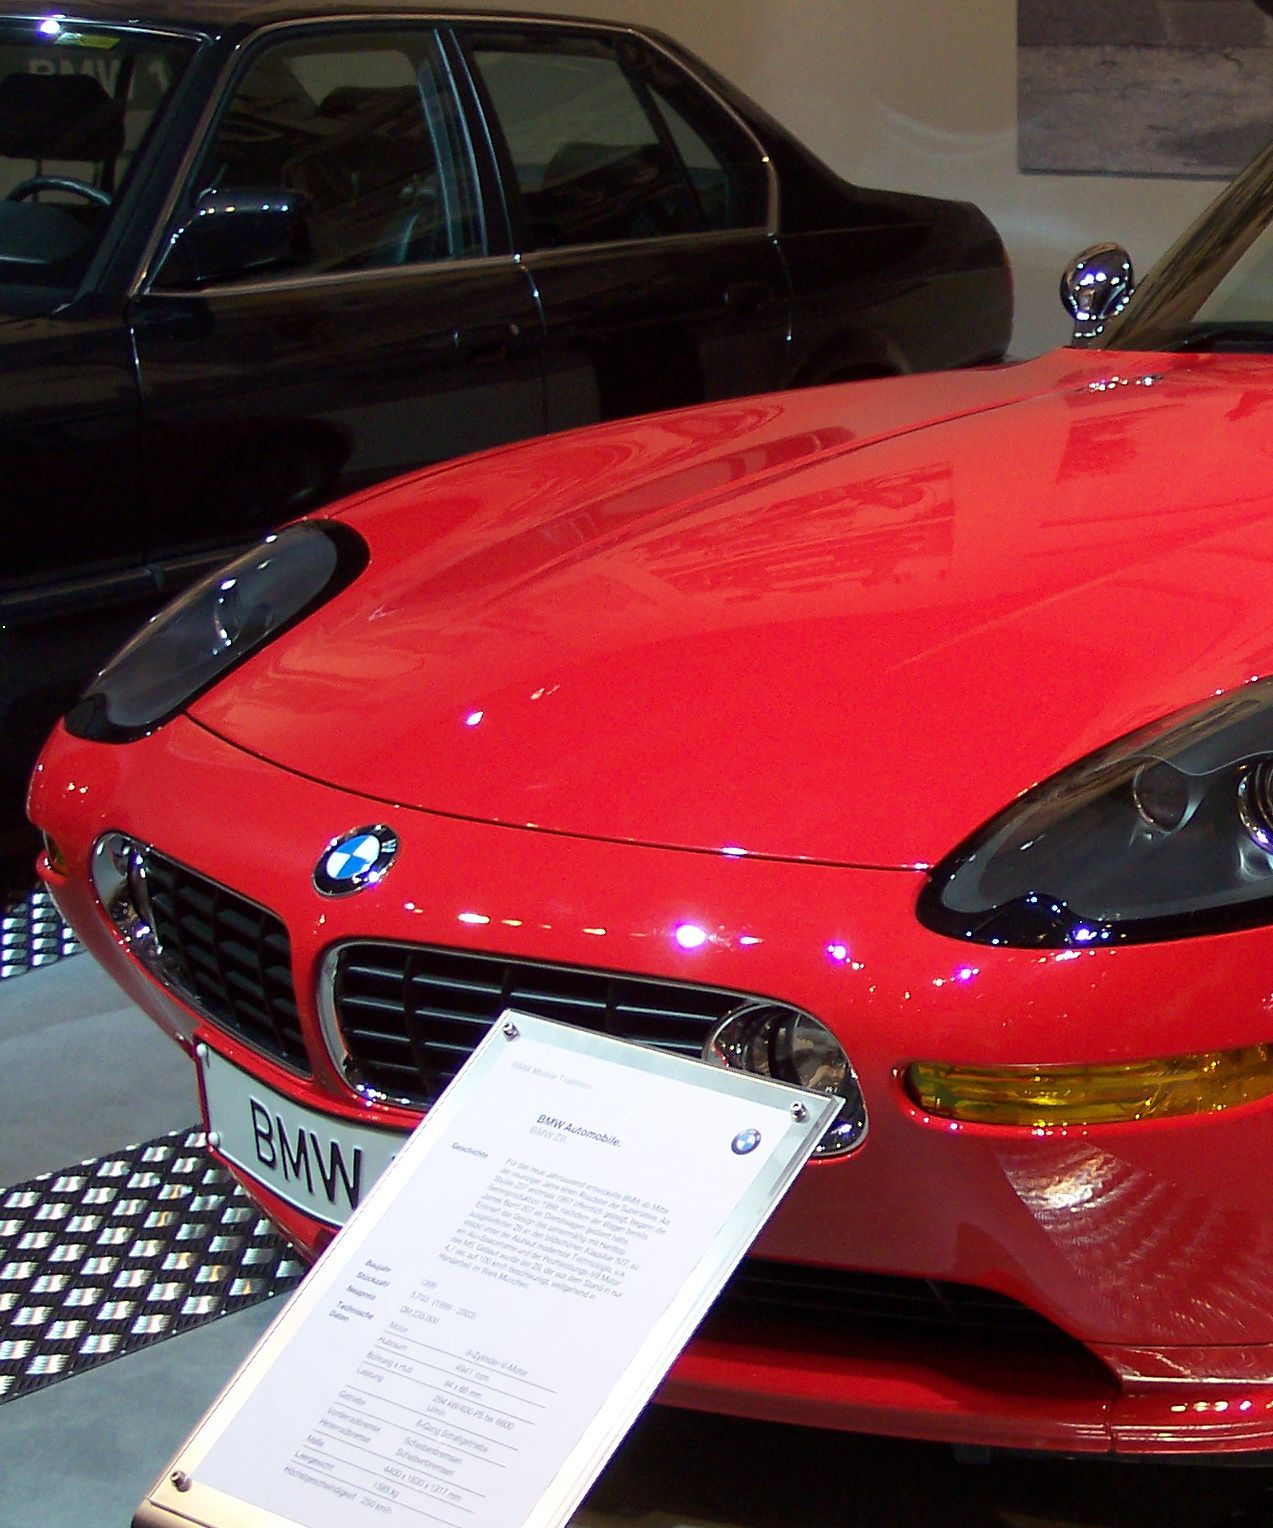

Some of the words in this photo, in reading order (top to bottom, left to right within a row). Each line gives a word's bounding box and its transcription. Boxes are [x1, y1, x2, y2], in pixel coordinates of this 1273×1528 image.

[528, 1125, 554, 1139] BMW
[536, 1113, 566, 1129] BMW
[563, 1122, 620, 1147] Automobile.
[250, 1098, 362, 1210] BMW
[451, 1141, 488, 1158] Geschichte
[355, 1271, 390, 1287] Stückzahl
[336, 1300, 374, 1320] Technische
